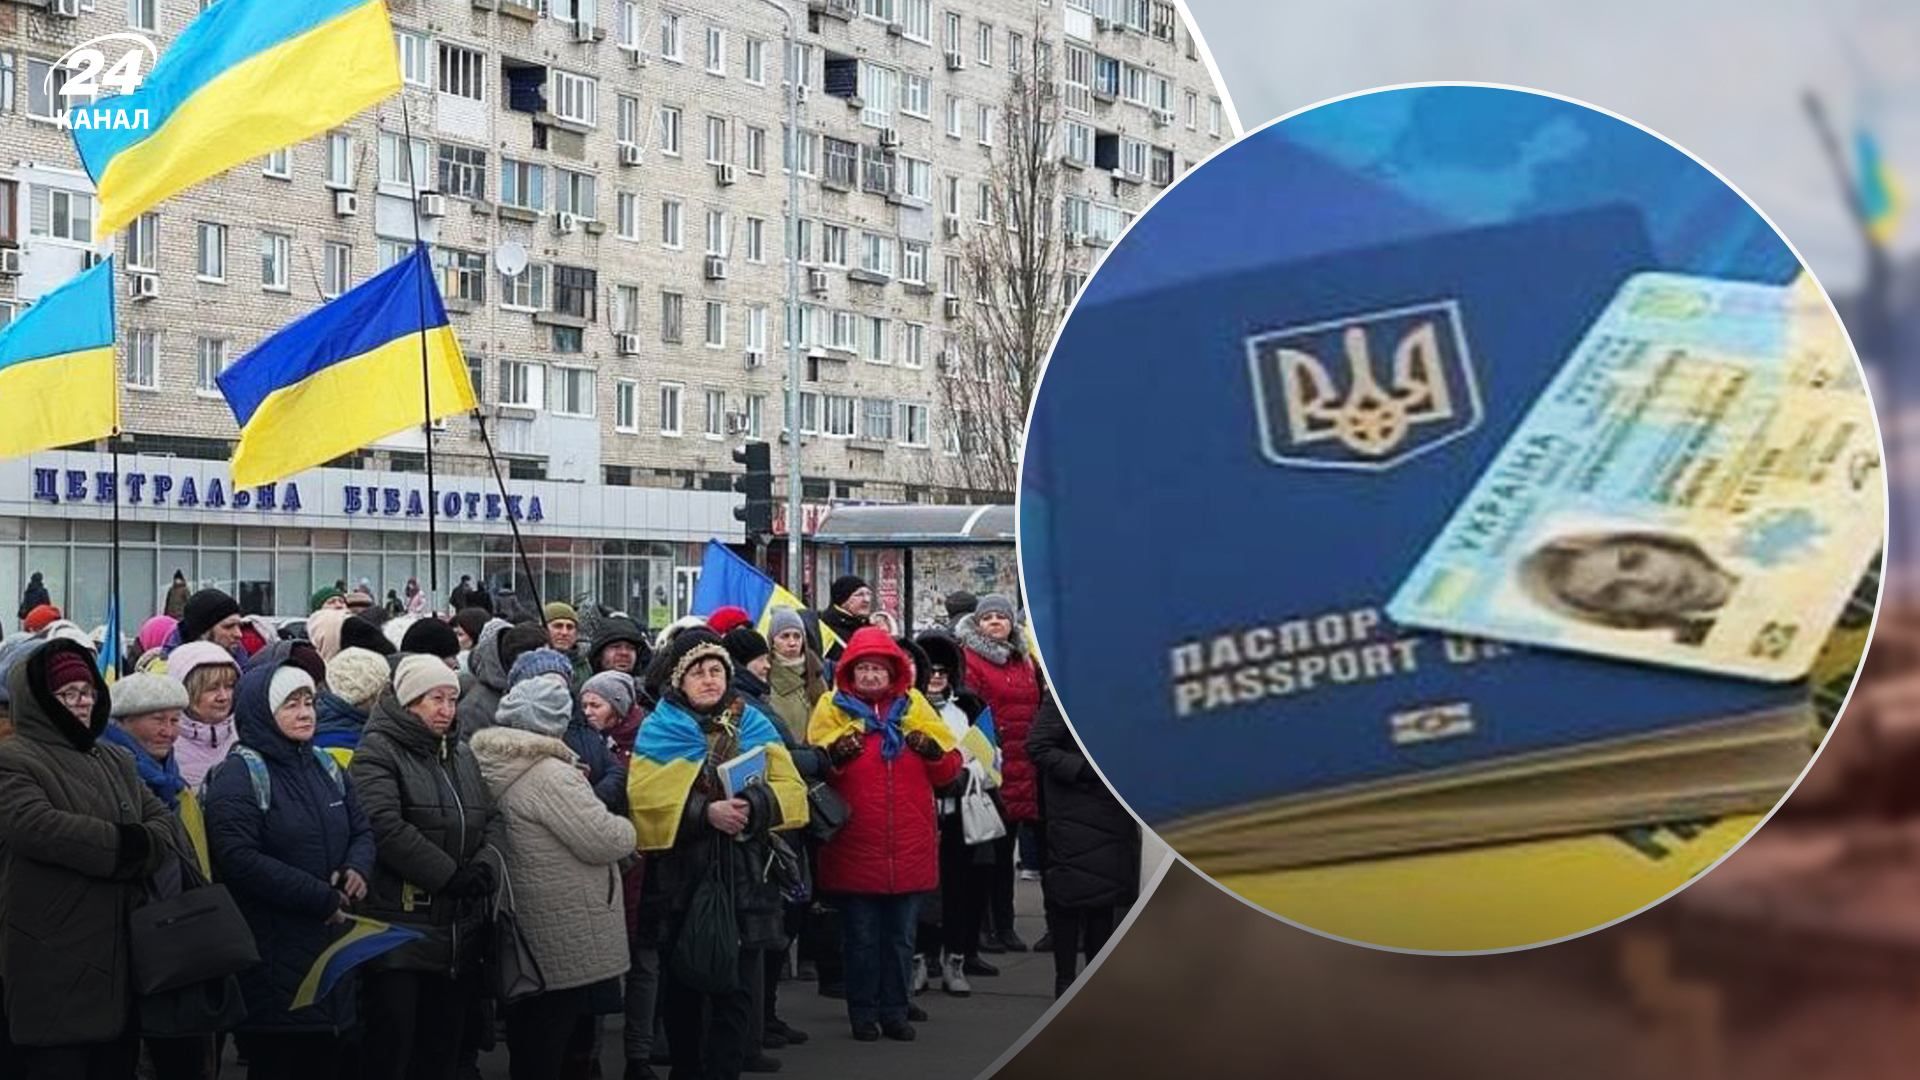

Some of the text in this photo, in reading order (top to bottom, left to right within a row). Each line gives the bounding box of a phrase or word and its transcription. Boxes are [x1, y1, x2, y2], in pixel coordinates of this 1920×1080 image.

[34, 468, 302, 511] ЦЕНТРАЛЬНА
[1171, 608, 1380, 675] ПАСПОР
[1175, 638, 1421, 715] PASSPORT
